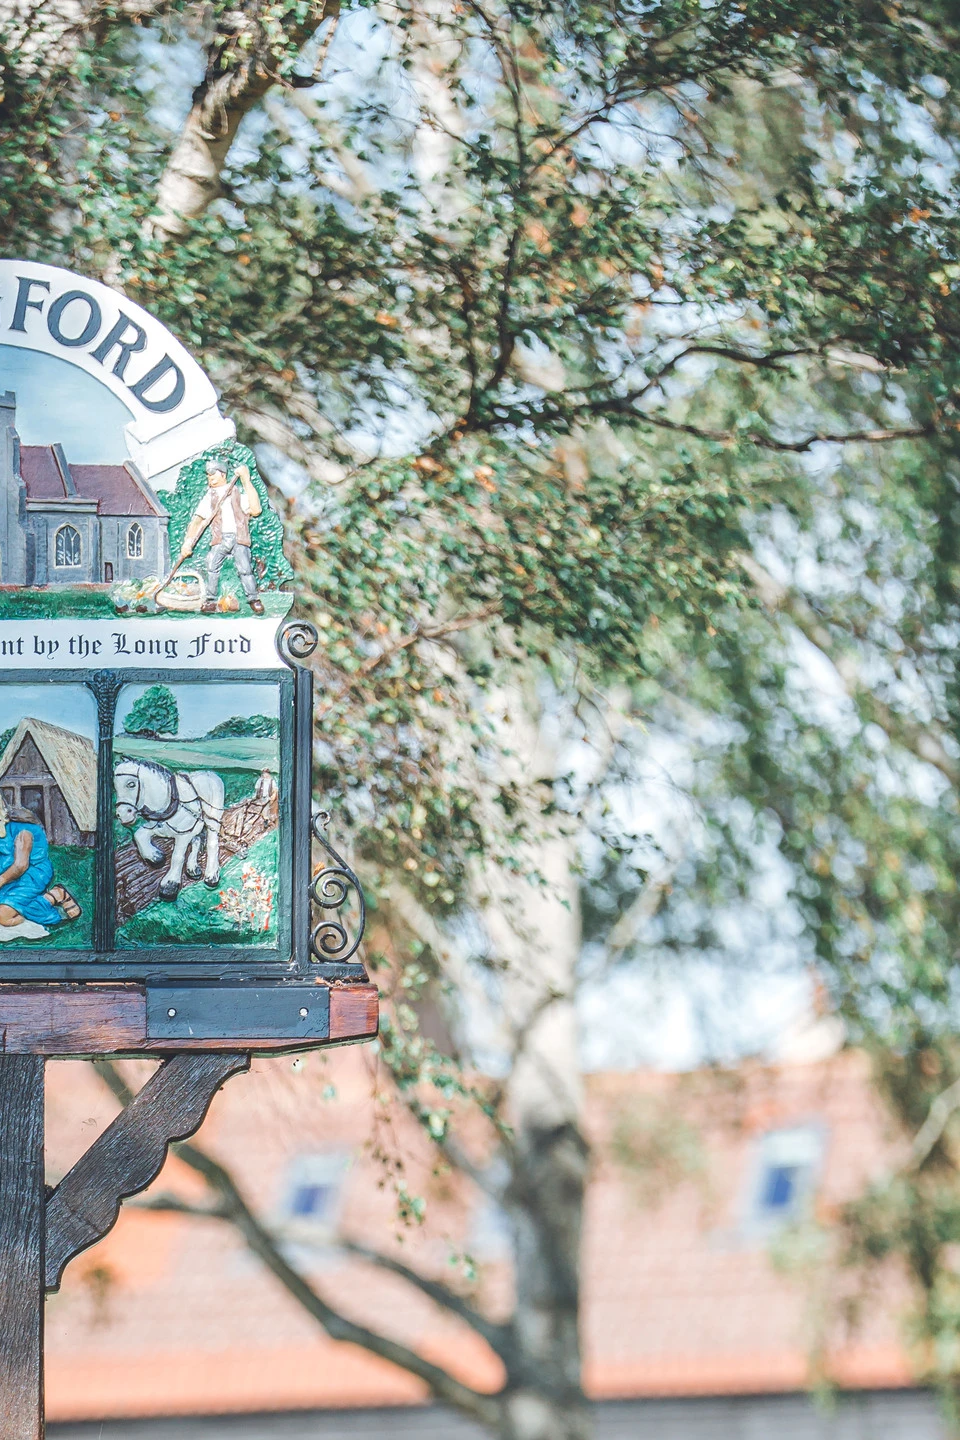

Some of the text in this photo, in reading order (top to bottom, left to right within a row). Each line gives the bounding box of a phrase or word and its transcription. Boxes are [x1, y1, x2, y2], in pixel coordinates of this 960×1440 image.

[33, 634, 60, 660] by
[68, 633, 102, 660] the
[111, 632, 178, 659] Long
[187, 632, 252, 658] Ford
